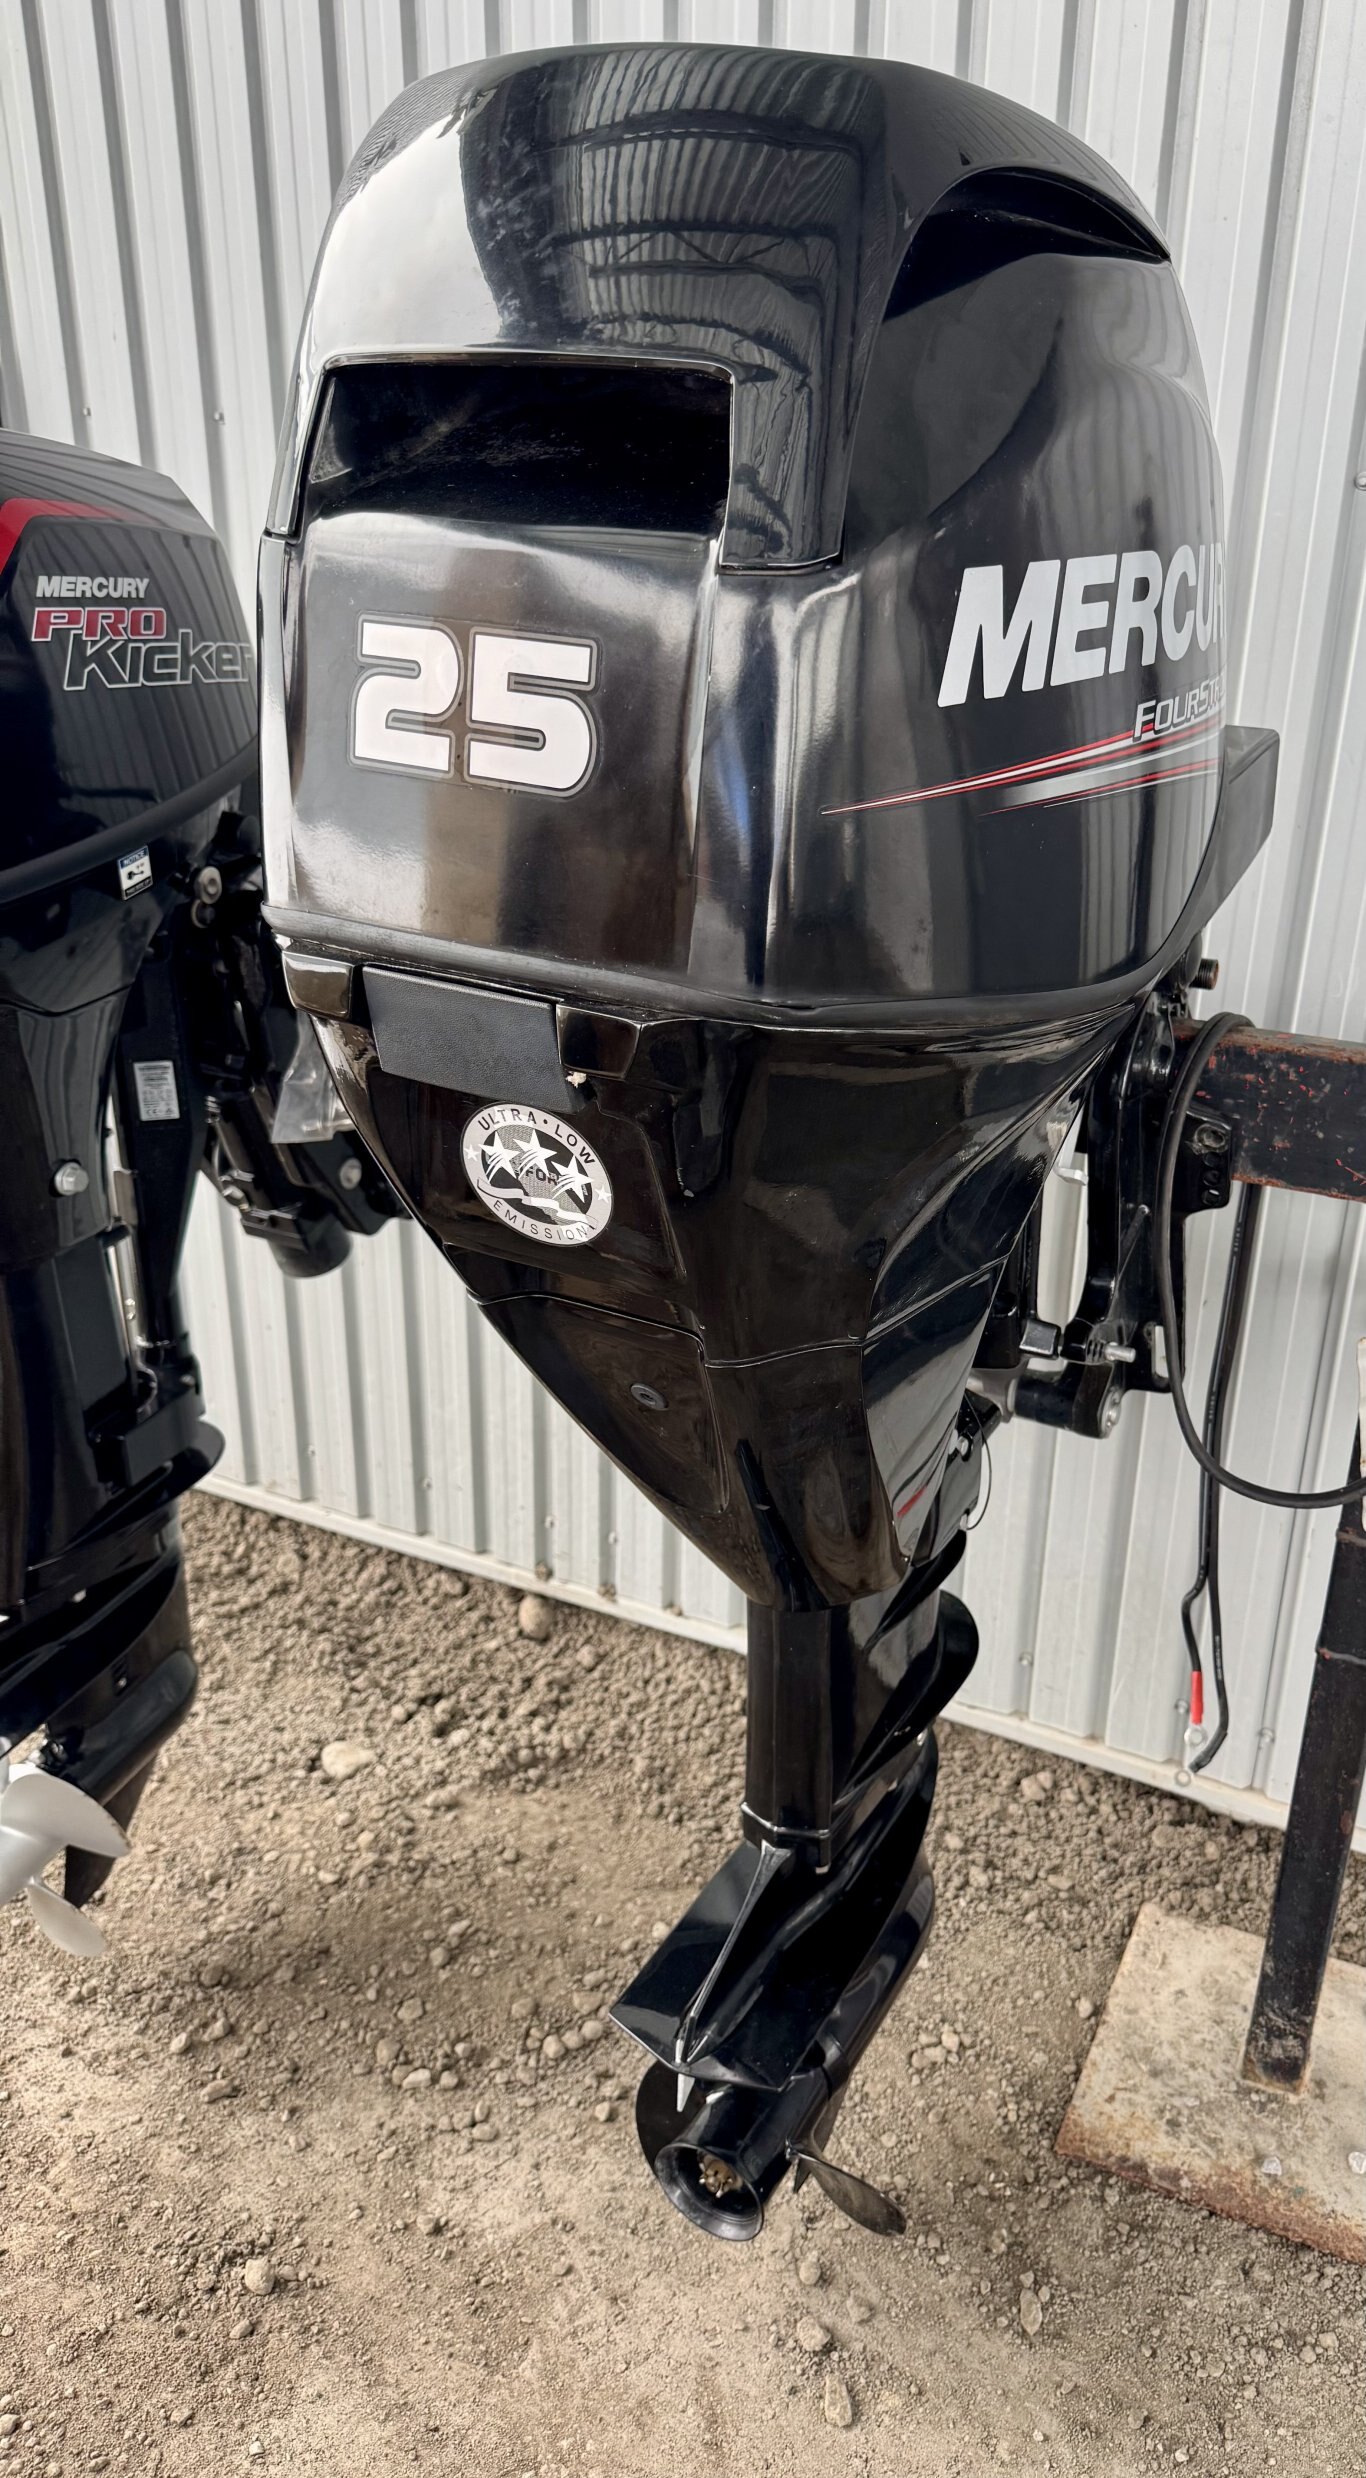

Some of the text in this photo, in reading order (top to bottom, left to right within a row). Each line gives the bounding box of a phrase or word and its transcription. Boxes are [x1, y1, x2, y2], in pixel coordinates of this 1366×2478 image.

[36, 575, 149, 598] MERCURY
[31, 607, 166, 641] PRO
[937, 542, 1226, 707] MERCUR
[349, 614, 598, 797] 25
[478, 1108, 595, 1164] ULTRA LOW
[493, 1200, 588, 1240] EMISSION
